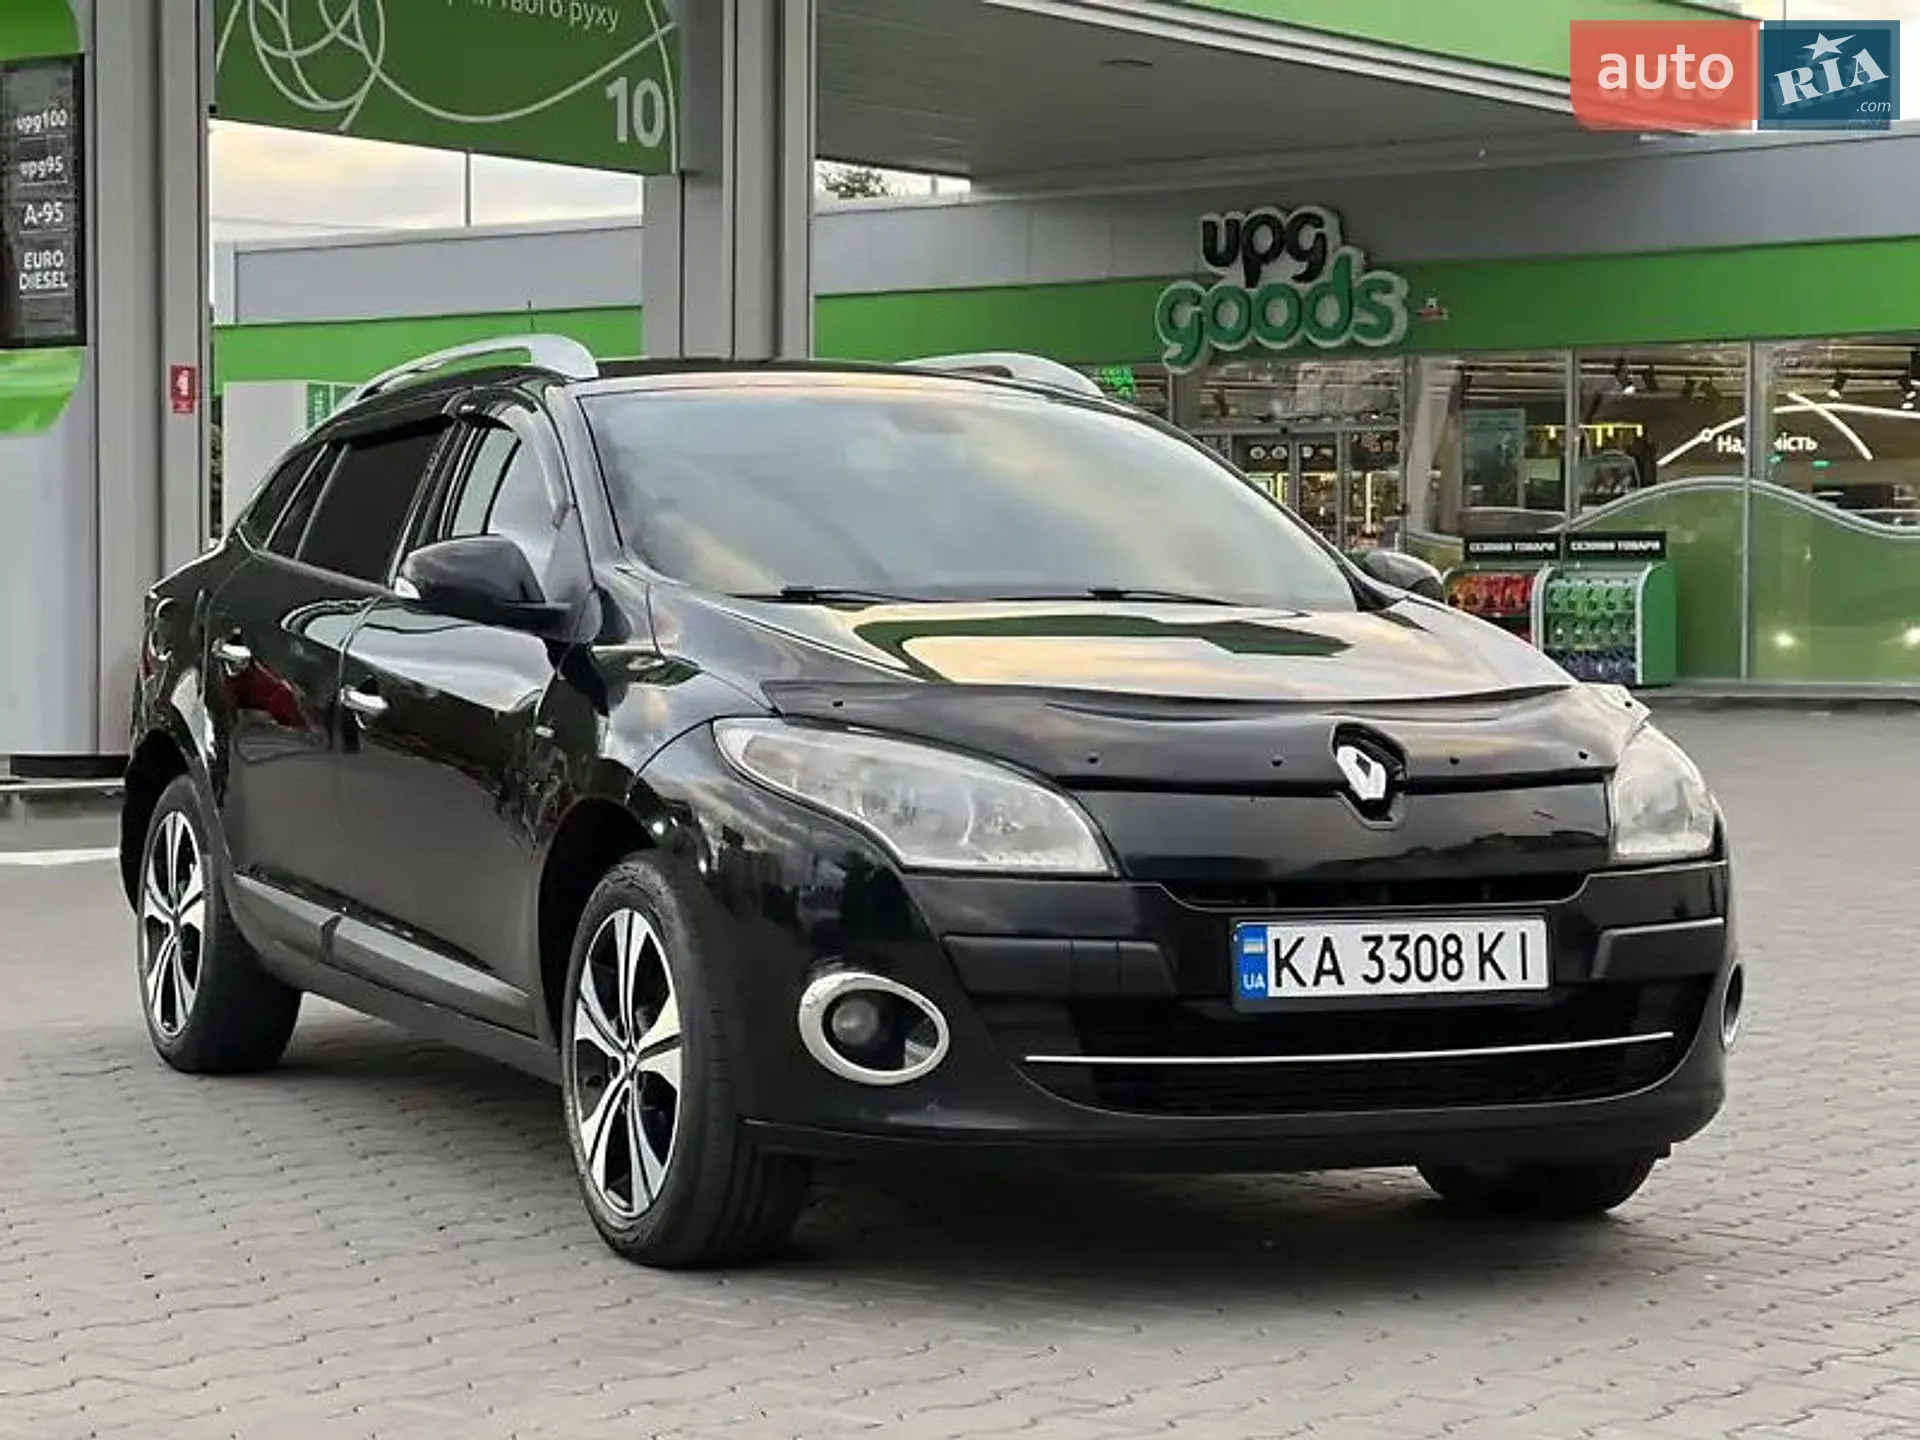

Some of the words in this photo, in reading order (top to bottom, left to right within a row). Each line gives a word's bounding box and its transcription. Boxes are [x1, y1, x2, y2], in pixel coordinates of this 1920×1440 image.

[569, 1, 619, 33] руху
[606, 76, 666, 147] 10
[24, 250, 65, 270] EURO
[1201, 209, 1329, 289] upg
[19, 271, 69, 290] DIESEL
[1156, 249, 1404, 371] goods
[1243, 972, 1266, 990] UA
[1273, 936, 1345, 988] KA
[1361, 933, 1465, 985] 3308
[1477, 931, 1528, 982] KI
